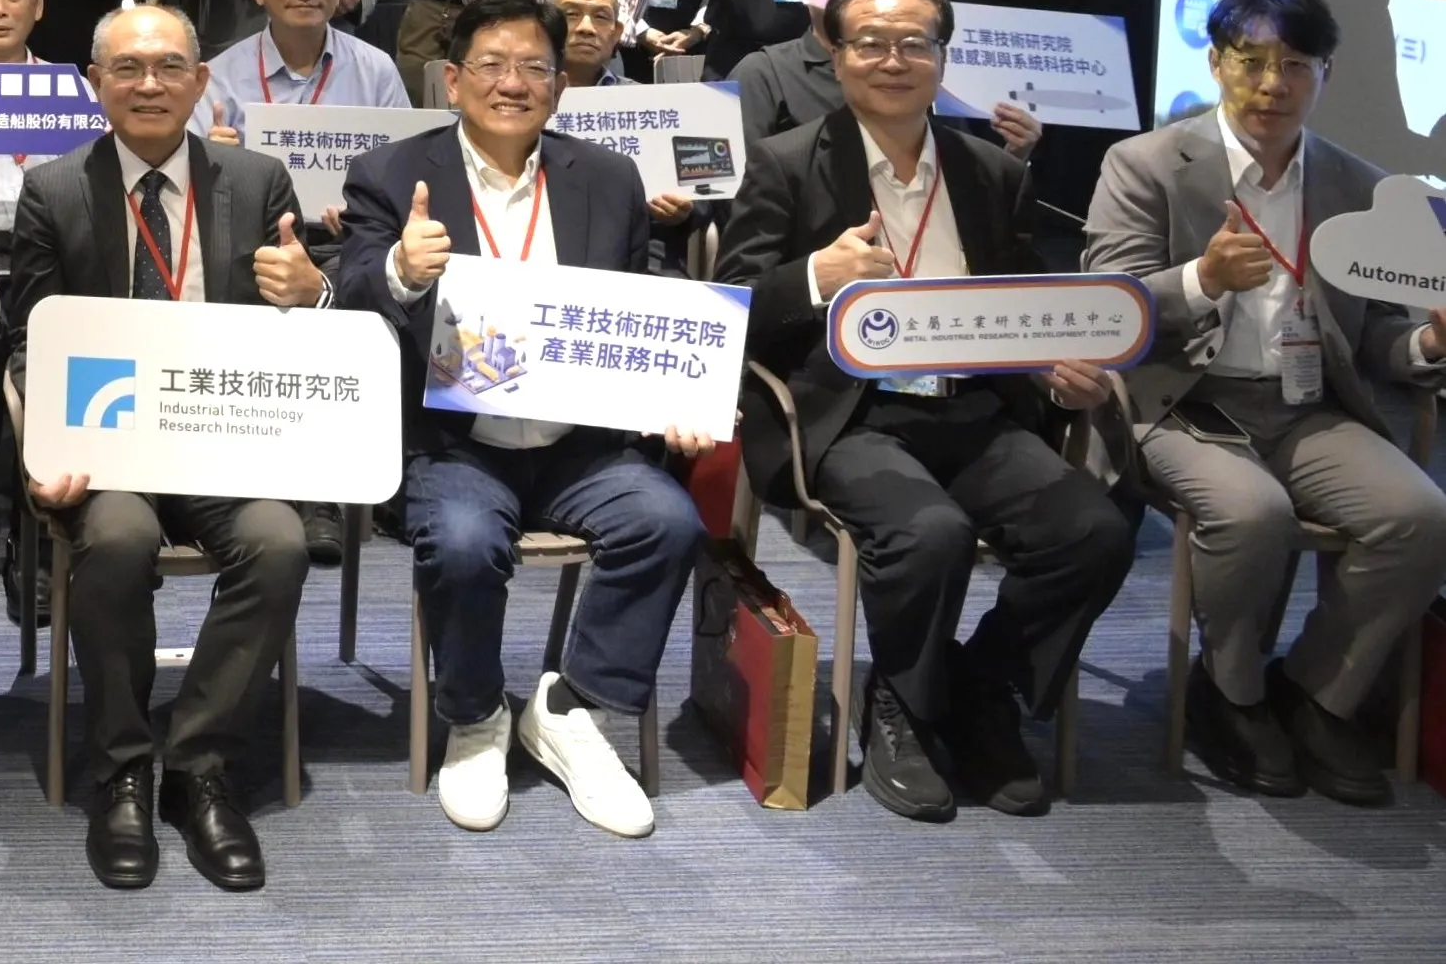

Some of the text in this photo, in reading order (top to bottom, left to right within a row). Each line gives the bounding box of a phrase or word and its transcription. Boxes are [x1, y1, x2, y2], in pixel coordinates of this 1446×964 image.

[962, 28, 1074, 54] 工業技術研究院
[950, 47, 1107, 76] 慧感測與系統科技中心
[552, 107, 681, 133] 業技術研究院
[260, 129, 390, 151] 工業技術研究院
[584, 135, 641, 156] 分院
[530, 302, 727, 349] 工業技術研究院
[905, 312, 1124, 331] 金屬工業研究發展中心
[539, 337, 708, 380] 產業服務中心
[159, 367, 361, 403] 工業技術研究院
[159, 401, 304, 423] Industrial Technology
[159, 418, 283, 437] Research Institute
